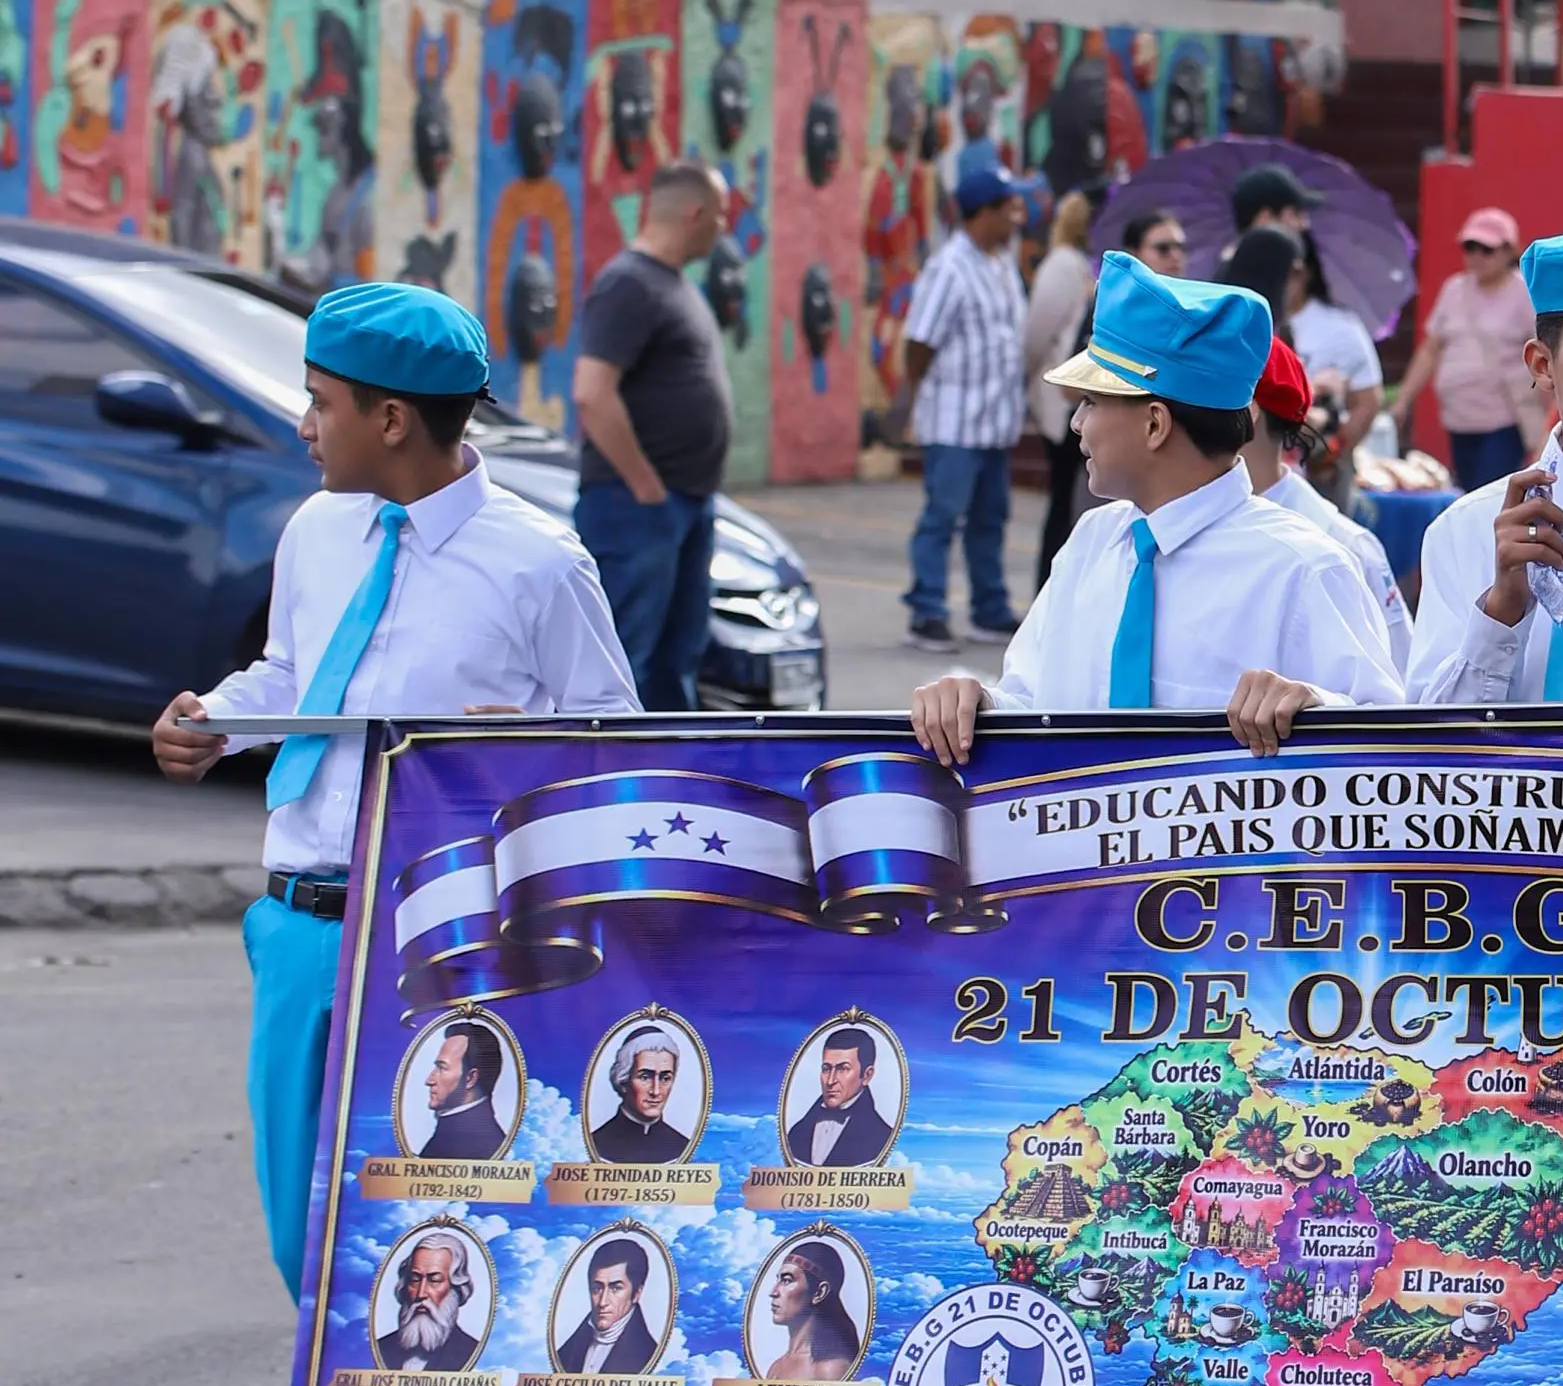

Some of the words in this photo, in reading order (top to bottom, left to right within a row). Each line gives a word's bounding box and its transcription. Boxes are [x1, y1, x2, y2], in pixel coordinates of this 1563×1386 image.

[1007, 774, 1327, 836] “EDUCANDO
[1097, 828, 1154, 868] EL
[1168, 818, 1275, 859] PAIS
[1291, 813, 1390, 856] QUE
[951, 975, 1062, 1043] 21
[1103, 971, 1248, 1045] DE
[1151, 1058, 1222, 1084] Cortés
[1288, 1056, 1386, 1081] Atlántida
[1467, 1069, 1527, 1093] Colón
[1123, 1107, 1166, 1126] Santa
[1302, 1115, 1350, 1138] Yoro
[1114, 1124, 1176, 1145] Bárbara
[1023, 1136, 1083, 1159] Copán
[404, 1163, 468, 1178] FRANCISCO
[472, 1162, 531, 1180] MORAZÁN
[594, 1168, 662, 1183] TRINIDAD
[666, 1169, 712, 1183] REYES
[1439, 1152, 1532, 1178] Olancho
[751, 1170, 814, 1186] DIONISIO
[817, 1171, 837, 1186] DE
[840, 1171, 906, 1187] HERRERA
[1193, 1176, 1283, 1199] Comayagua
[408, 1183, 483, 1200] (1792-1842)
[584, 1187, 676, 1204] (1797-1855)
[780, 1192, 870, 1209] (1781-1850)
[986, 1221, 1068, 1242] Ocotepeque
[1299, 1219, 1378, 1239] Francisco
[1103, 1231, 1168, 1250] Intibucá
[1302, 1238, 1376, 1258] Morazán
[1187, 1272, 1209, 1291] La
[1212, 1272, 1246, 1292] Paz
[1402, 1270, 1423, 1292] El
[1428, 1271, 1505, 1295] Paraíso
[948, 1295, 977, 1323] 21
[988, 1291, 1021, 1311] DE
[1203, 1359, 1249, 1380] Valle
[1280, 1363, 1372, 1386] Choluteca
